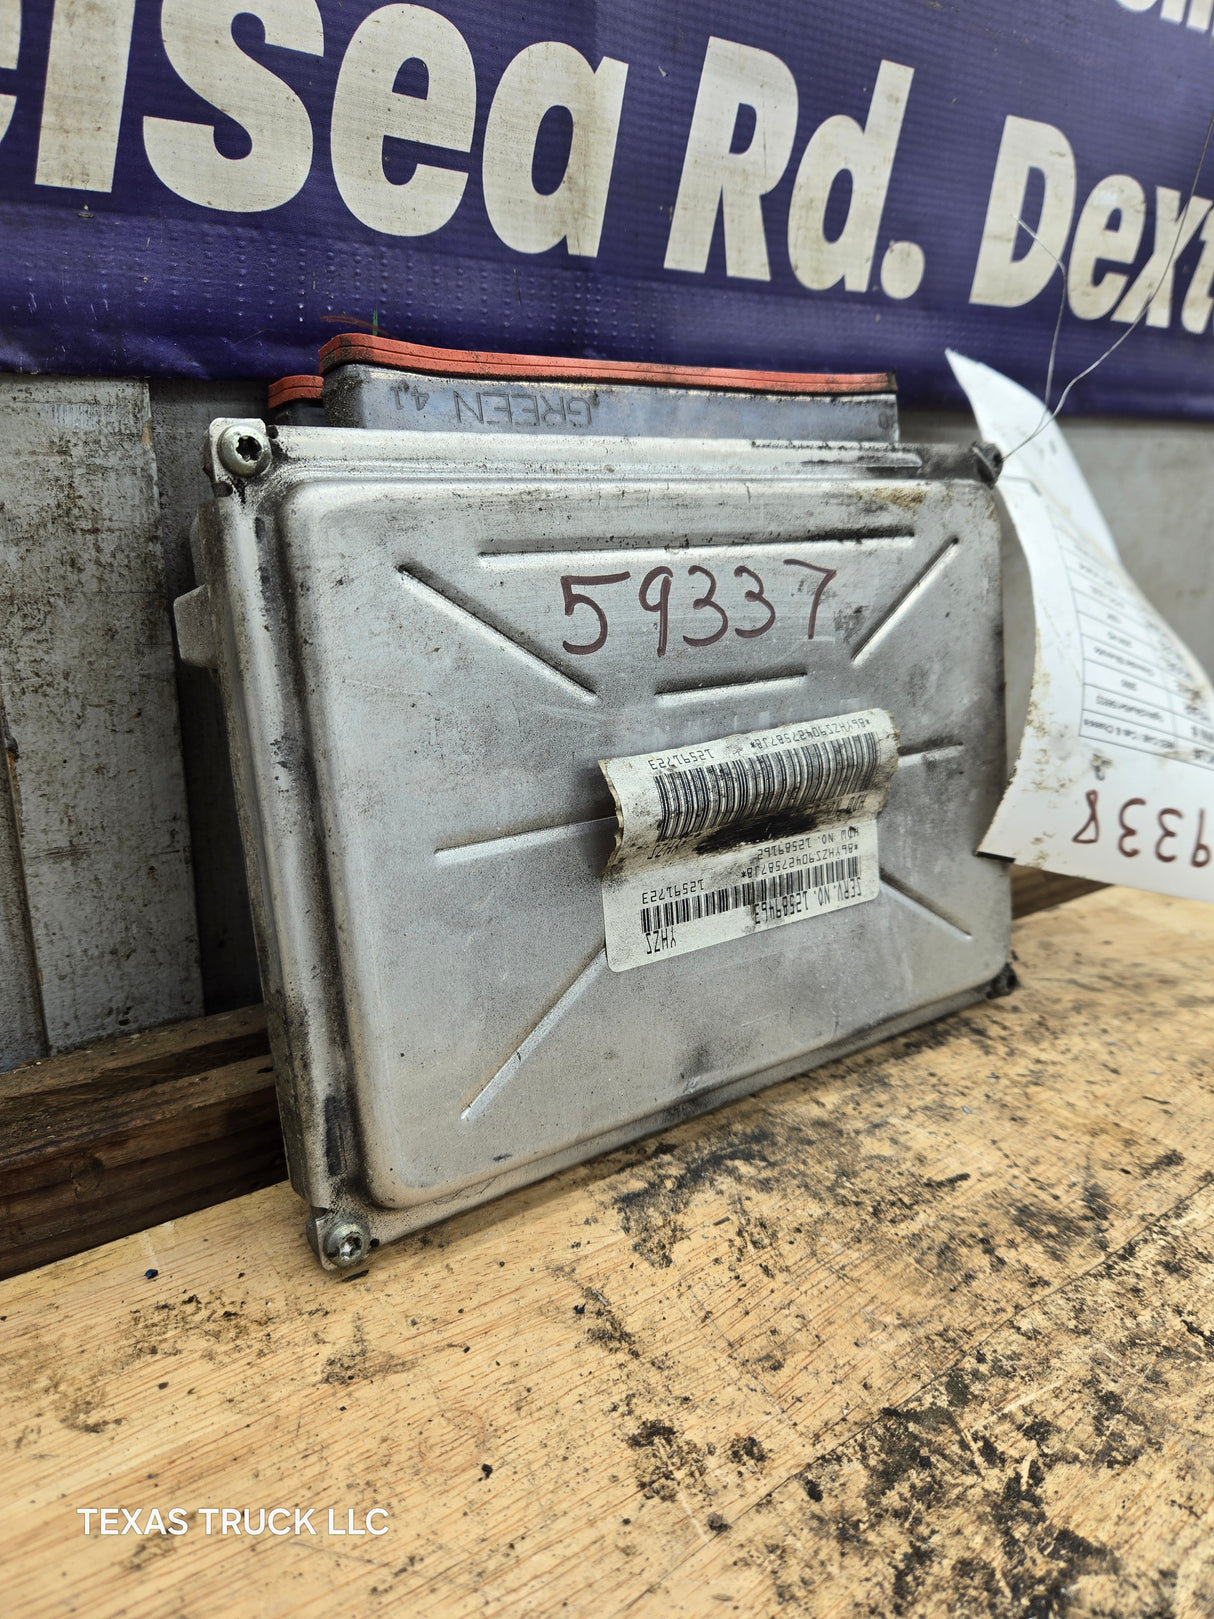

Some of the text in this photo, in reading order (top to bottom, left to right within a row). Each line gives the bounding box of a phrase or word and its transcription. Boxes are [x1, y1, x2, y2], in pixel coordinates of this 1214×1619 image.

[0, 0, 629, 258] lsea
[664, 36, 925, 299] Rd.
[453, 390, 592, 427] GREEN
[560, 558, 836, 657] 59337
[648, 748, 714, 770] 12591723
[757, 837, 812, 860] 12589162
[817, 831, 834, 844] NO.
[642, 879, 704, 905] 12591723
[754, 877, 863, 925] SERV. NO. 12589463
